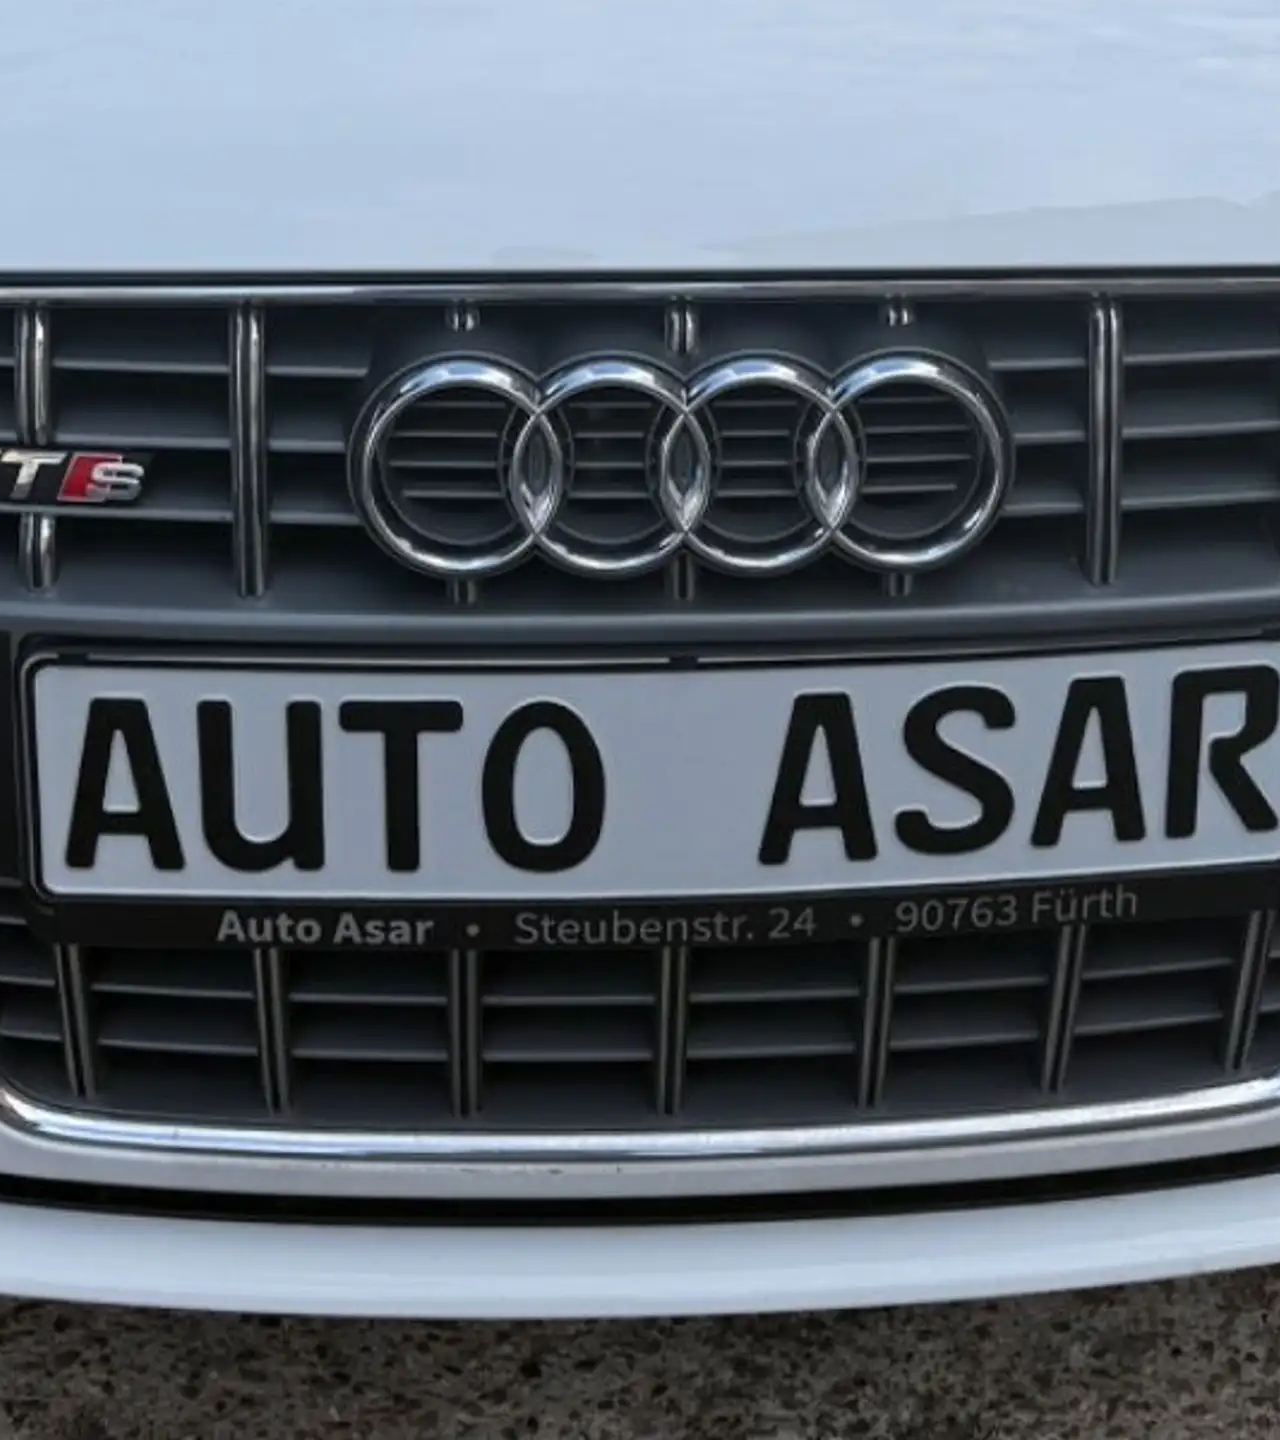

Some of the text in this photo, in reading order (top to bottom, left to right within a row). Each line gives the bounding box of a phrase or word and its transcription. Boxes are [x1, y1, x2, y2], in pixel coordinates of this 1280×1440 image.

[64, 697, 607, 873] AUTO
[216, 882, 1138, 945] Auto Asar Steubenstr. 24 90763 Fürth
